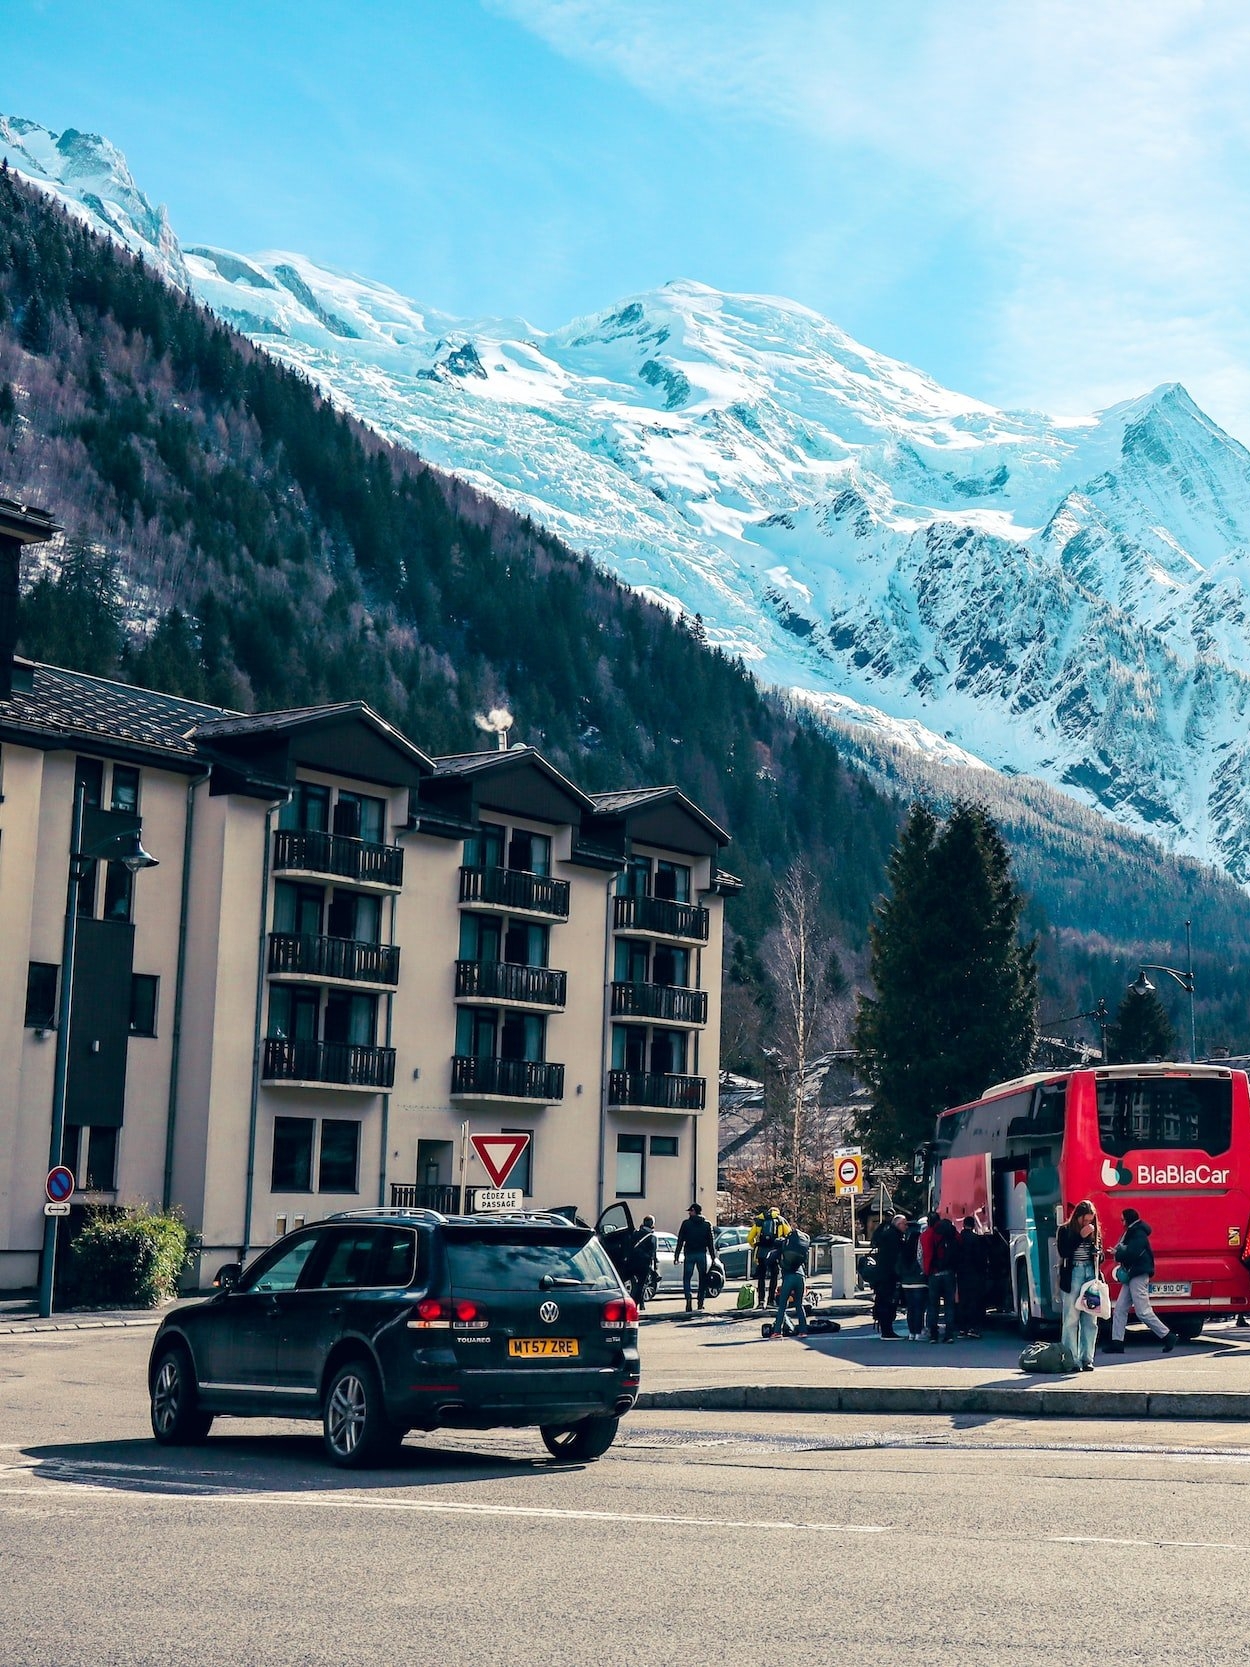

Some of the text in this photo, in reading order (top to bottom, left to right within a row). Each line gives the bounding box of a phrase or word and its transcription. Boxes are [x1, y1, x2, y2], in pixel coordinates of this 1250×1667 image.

[1137, 1165, 1230, 1184] BlaBlaCar
[481, 1200, 516, 1208] PASSAGE
[513, 1340, 574, 1354] MT57 ZRE
